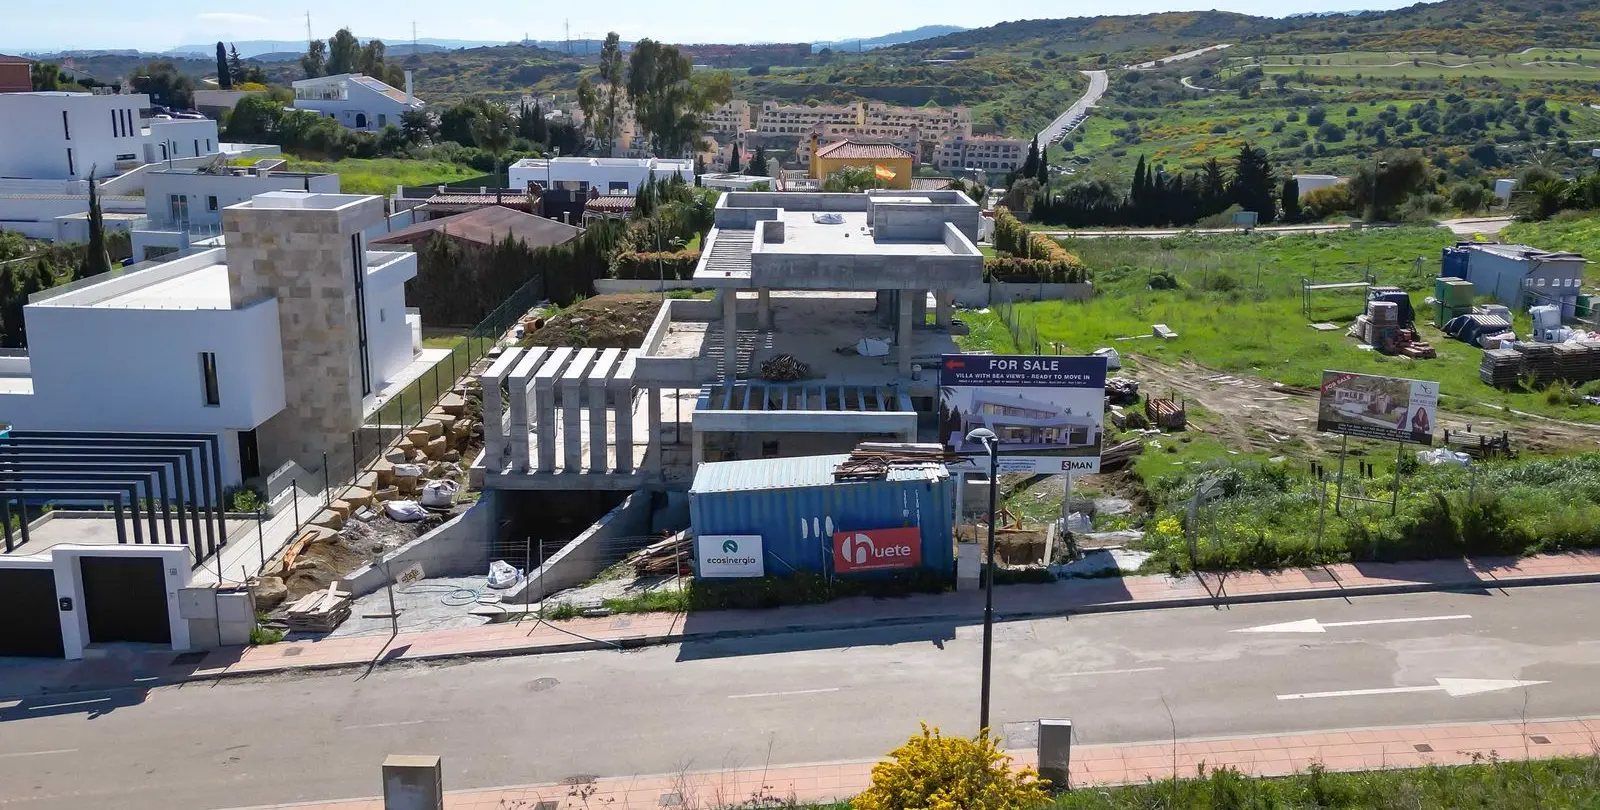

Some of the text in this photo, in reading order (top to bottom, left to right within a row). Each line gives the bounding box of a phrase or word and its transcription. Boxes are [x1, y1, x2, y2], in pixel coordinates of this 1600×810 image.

[989, 360, 1059, 371] FOR SALE
[842, 533, 911, 564] huete
[707, 556, 756, 565] ecosinergia
